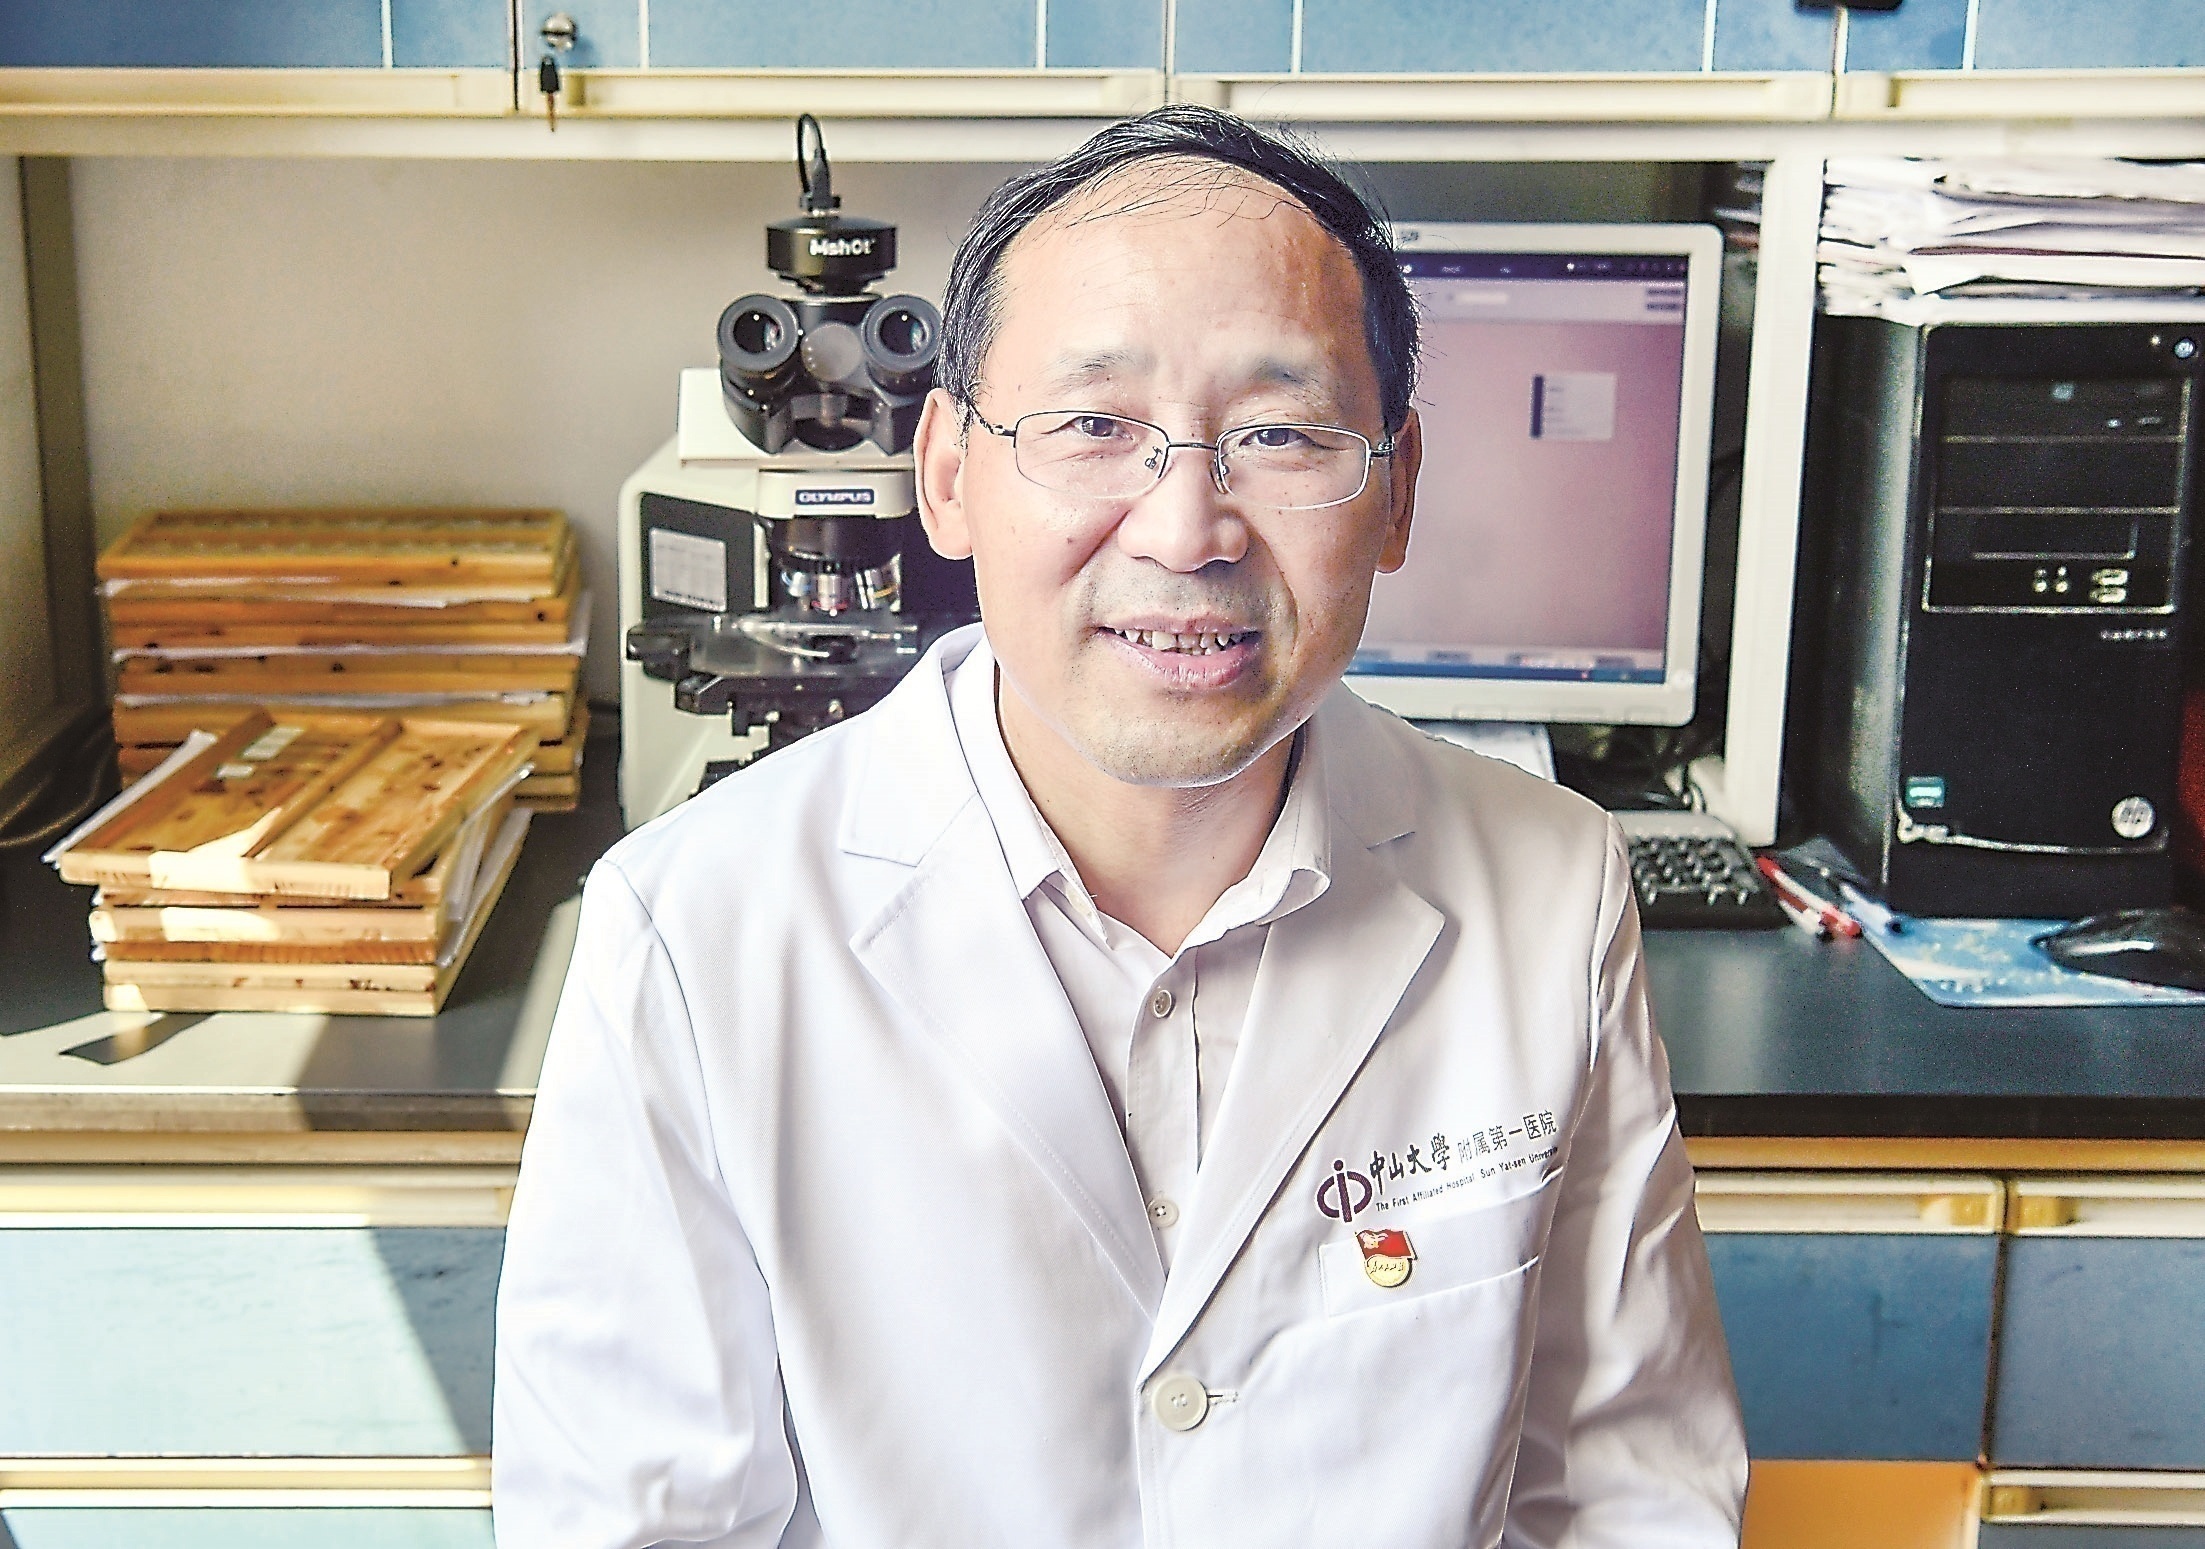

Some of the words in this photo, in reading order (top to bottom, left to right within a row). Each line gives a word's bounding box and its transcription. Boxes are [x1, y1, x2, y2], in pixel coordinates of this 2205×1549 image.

[798, 491, 872, 503] OLYMPUS
[1457, 1109, 1558, 1164] 附属第一医院
[1375, 1202, 1389, 1212] The
[1392, 1196, 1410, 1208] First
[1412, 1184, 1444, 1202] Affiliated
[1446, 1172, 1475, 1190] Hospital
[1480, 1167, 1496, 1179] Sun
[1498, 1157, 1527, 1172] Yat-sen
